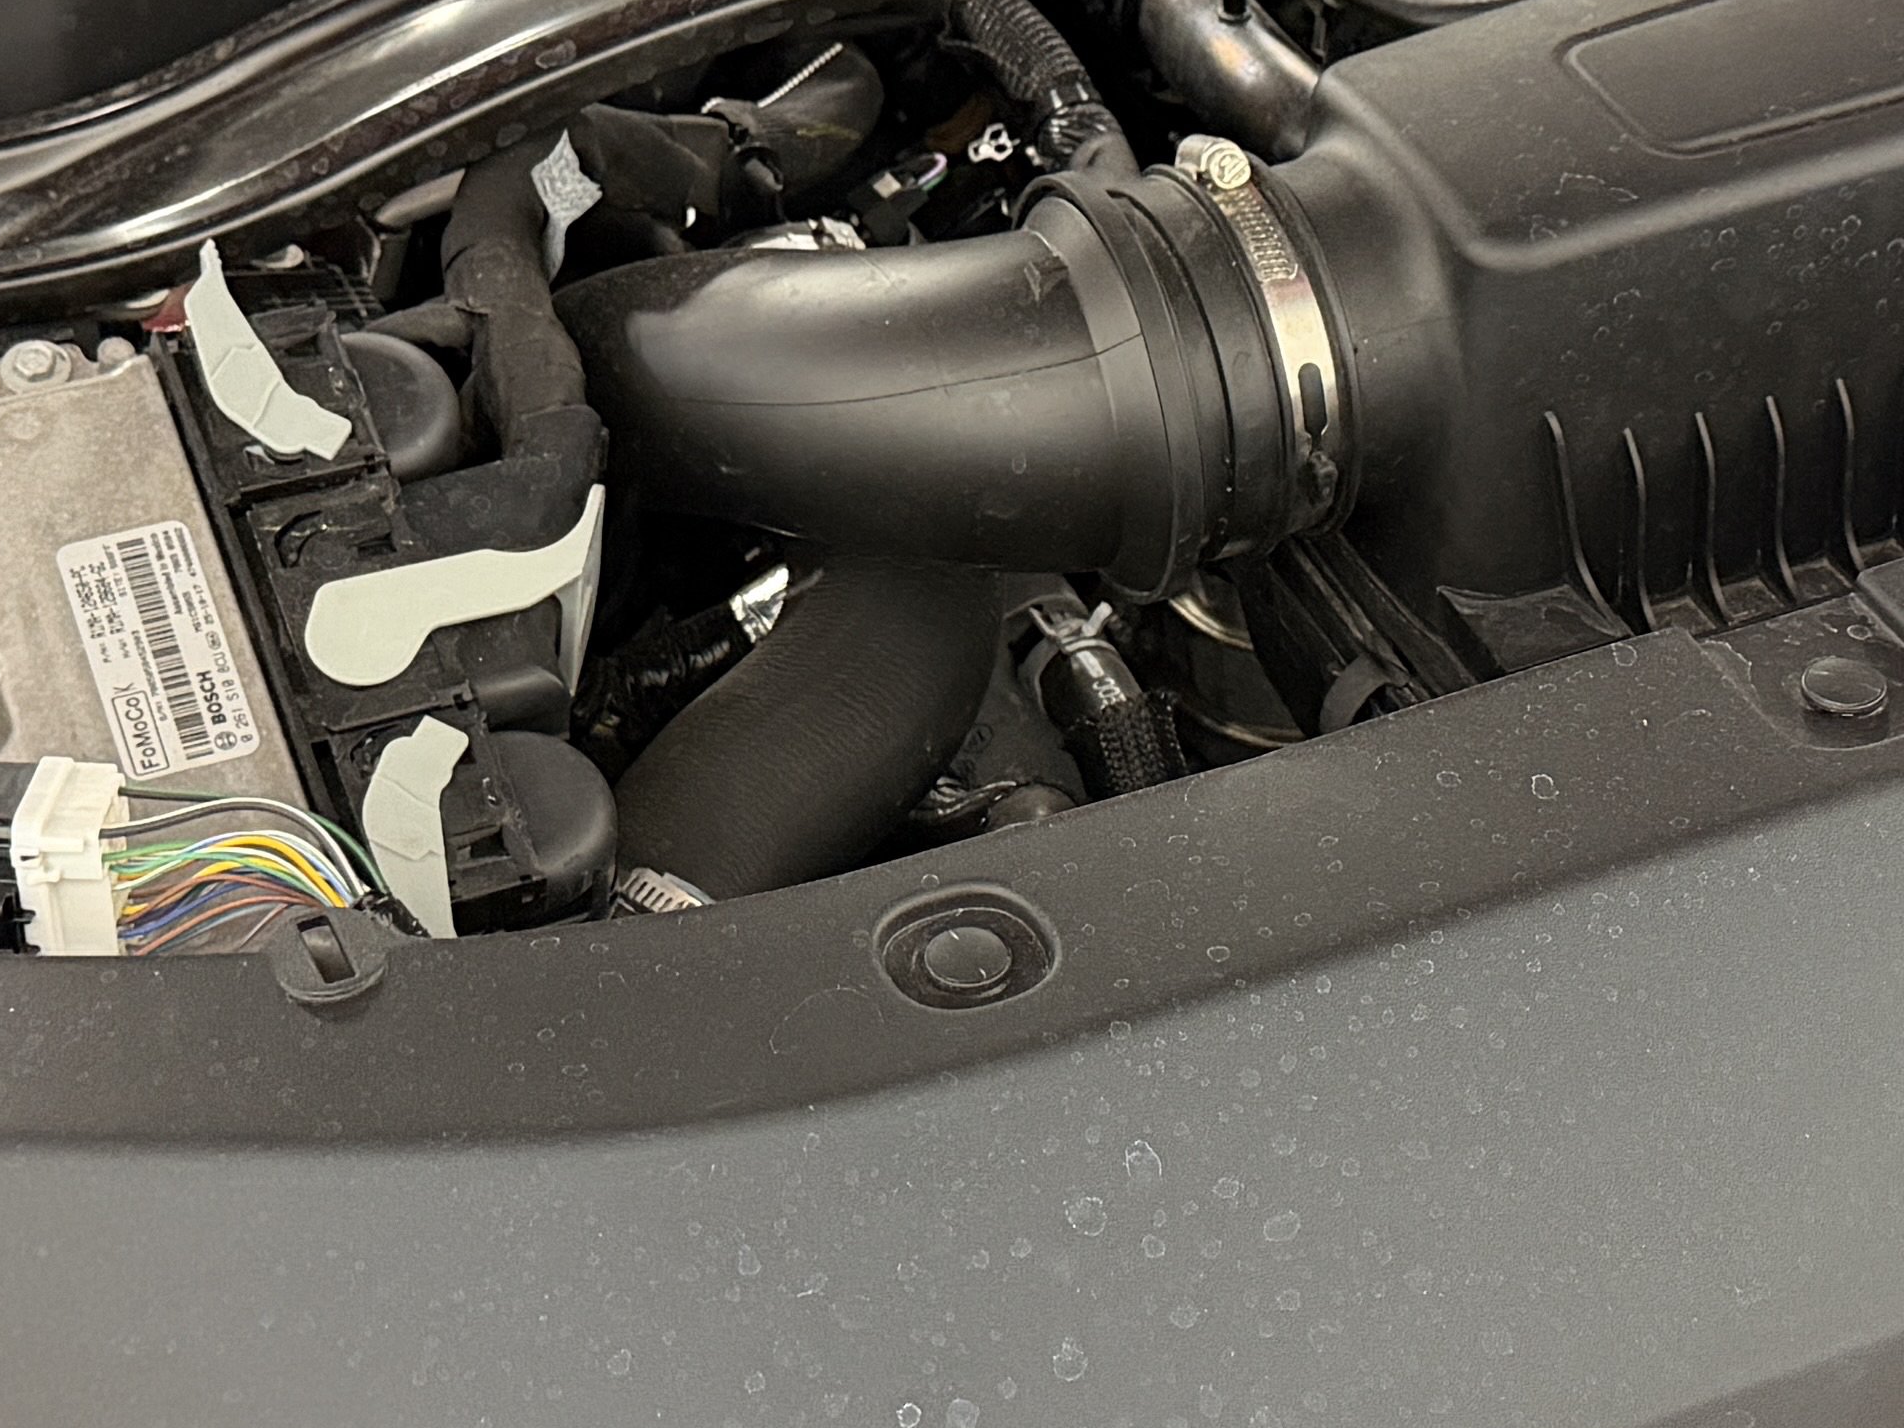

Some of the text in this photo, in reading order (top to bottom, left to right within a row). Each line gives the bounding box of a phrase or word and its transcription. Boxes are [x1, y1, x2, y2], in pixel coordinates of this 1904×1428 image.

[196, 670, 227, 726] BOSCH
[231, 707, 250, 730] 261
[124, 696, 161, 771] FoMoCo
